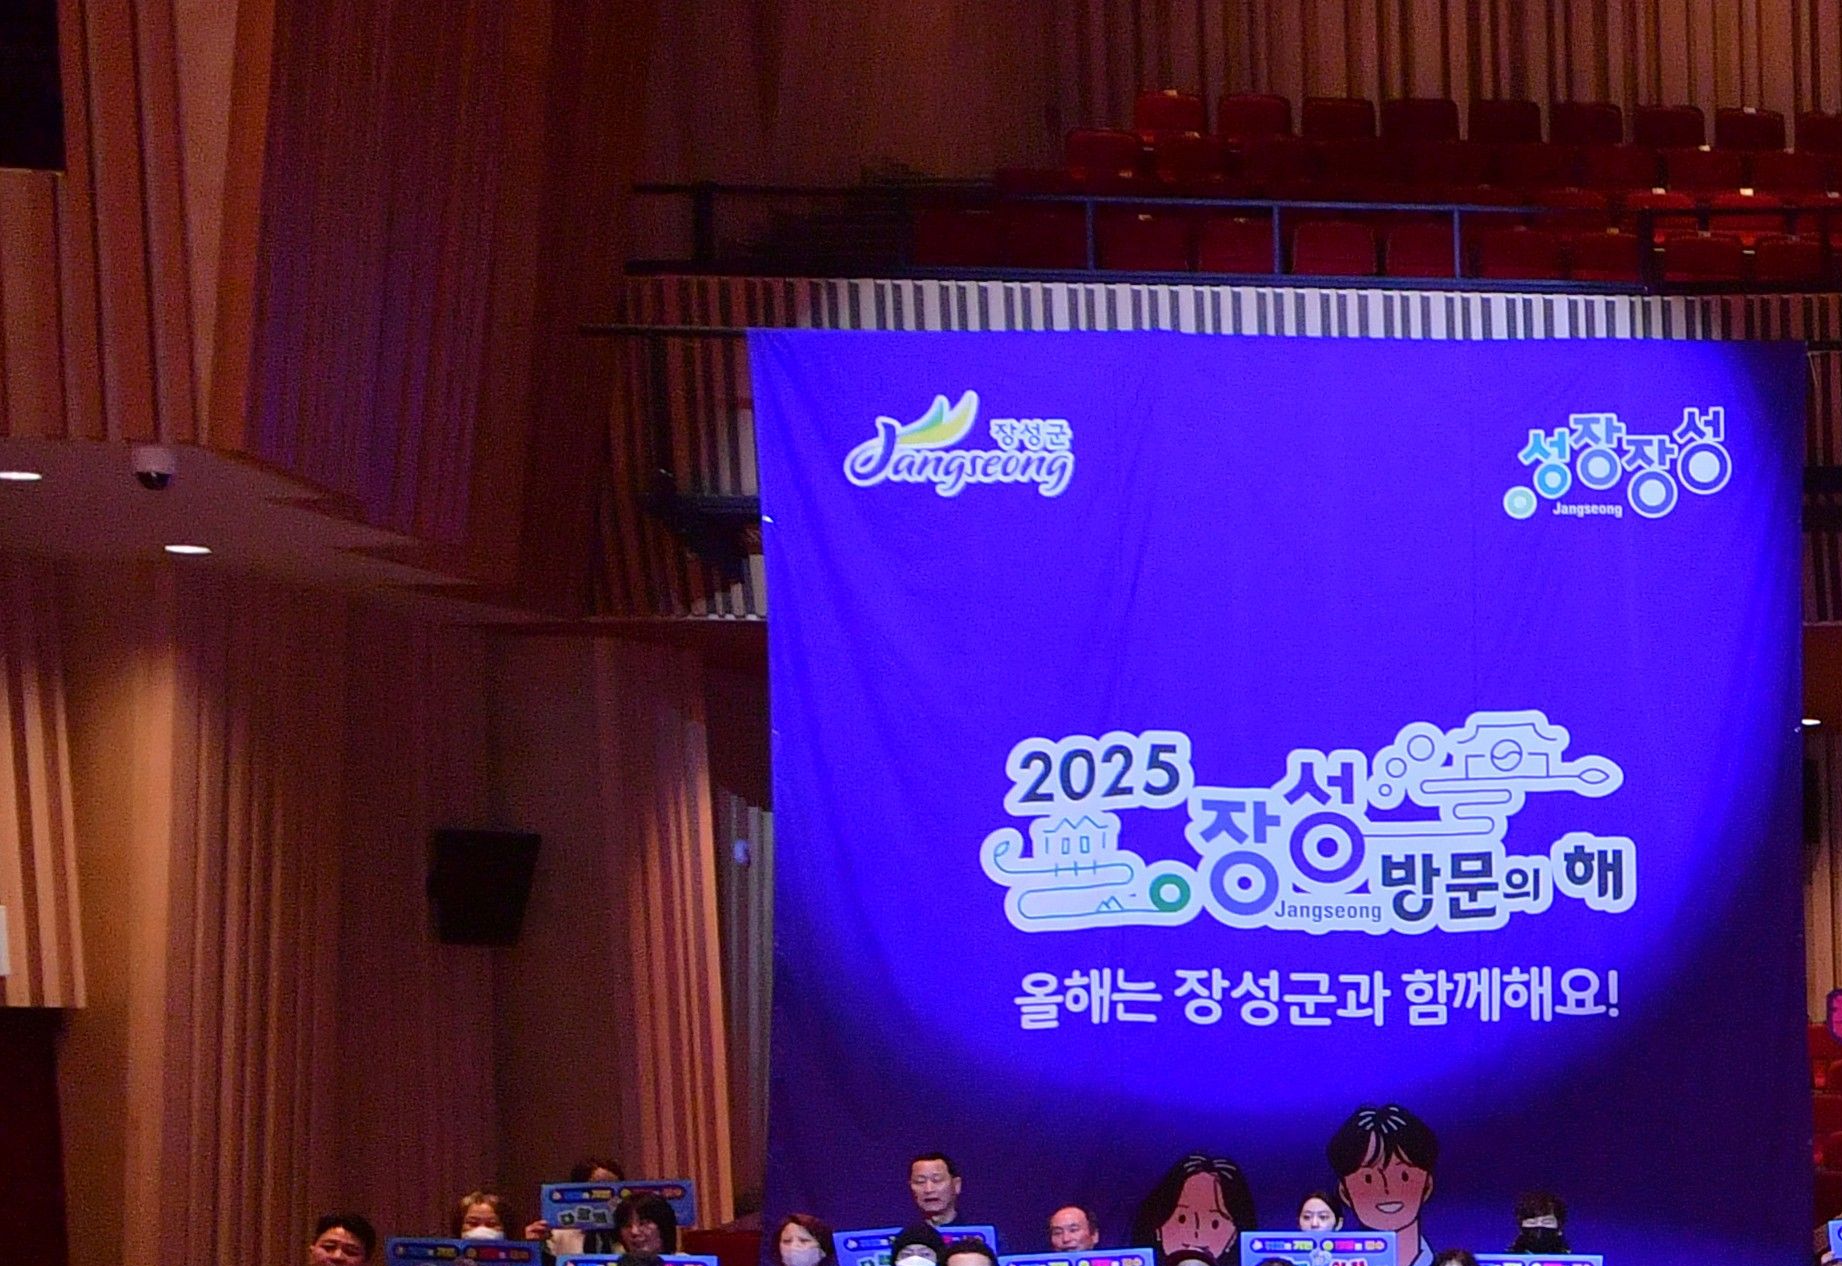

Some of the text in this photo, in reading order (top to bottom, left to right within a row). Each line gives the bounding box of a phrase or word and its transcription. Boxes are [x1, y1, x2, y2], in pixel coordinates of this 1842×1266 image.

[846, 418, 1075, 495] Jangseong
[993, 420, 1070, 450] 장성군
[1553, 502, 1623, 518] Jangseong
[1018, 743, 1181, 802] 2025
[1199, 760, 1624, 922] 장성 방문의 해
[1273, 899, 1382, 923] Jangseong
[1014, 966, 1620, 1030] 올해는 장성군과 함께해요!
